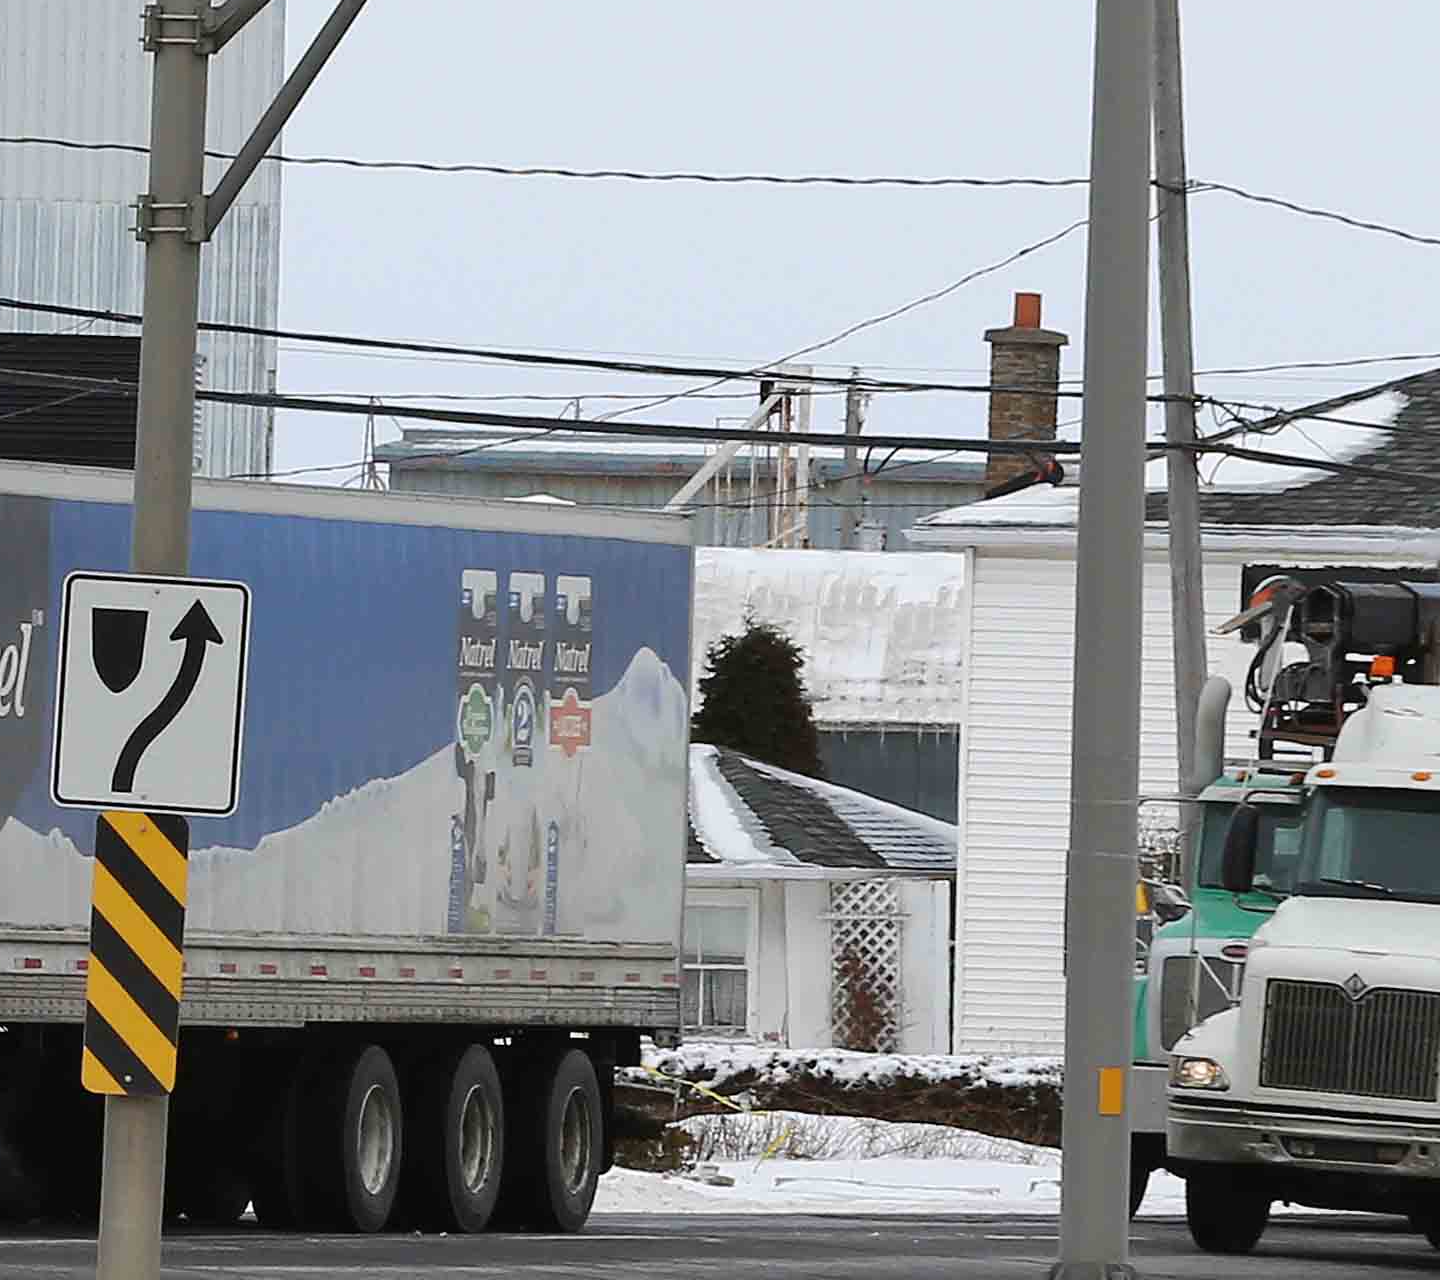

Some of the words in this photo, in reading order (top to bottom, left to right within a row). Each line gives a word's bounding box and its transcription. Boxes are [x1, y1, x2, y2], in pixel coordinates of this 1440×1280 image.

[459, 636, 496, 668] Natrel
[506, 639, 545, 670] Natrel
[554, 642, 591, 673] Natrel
